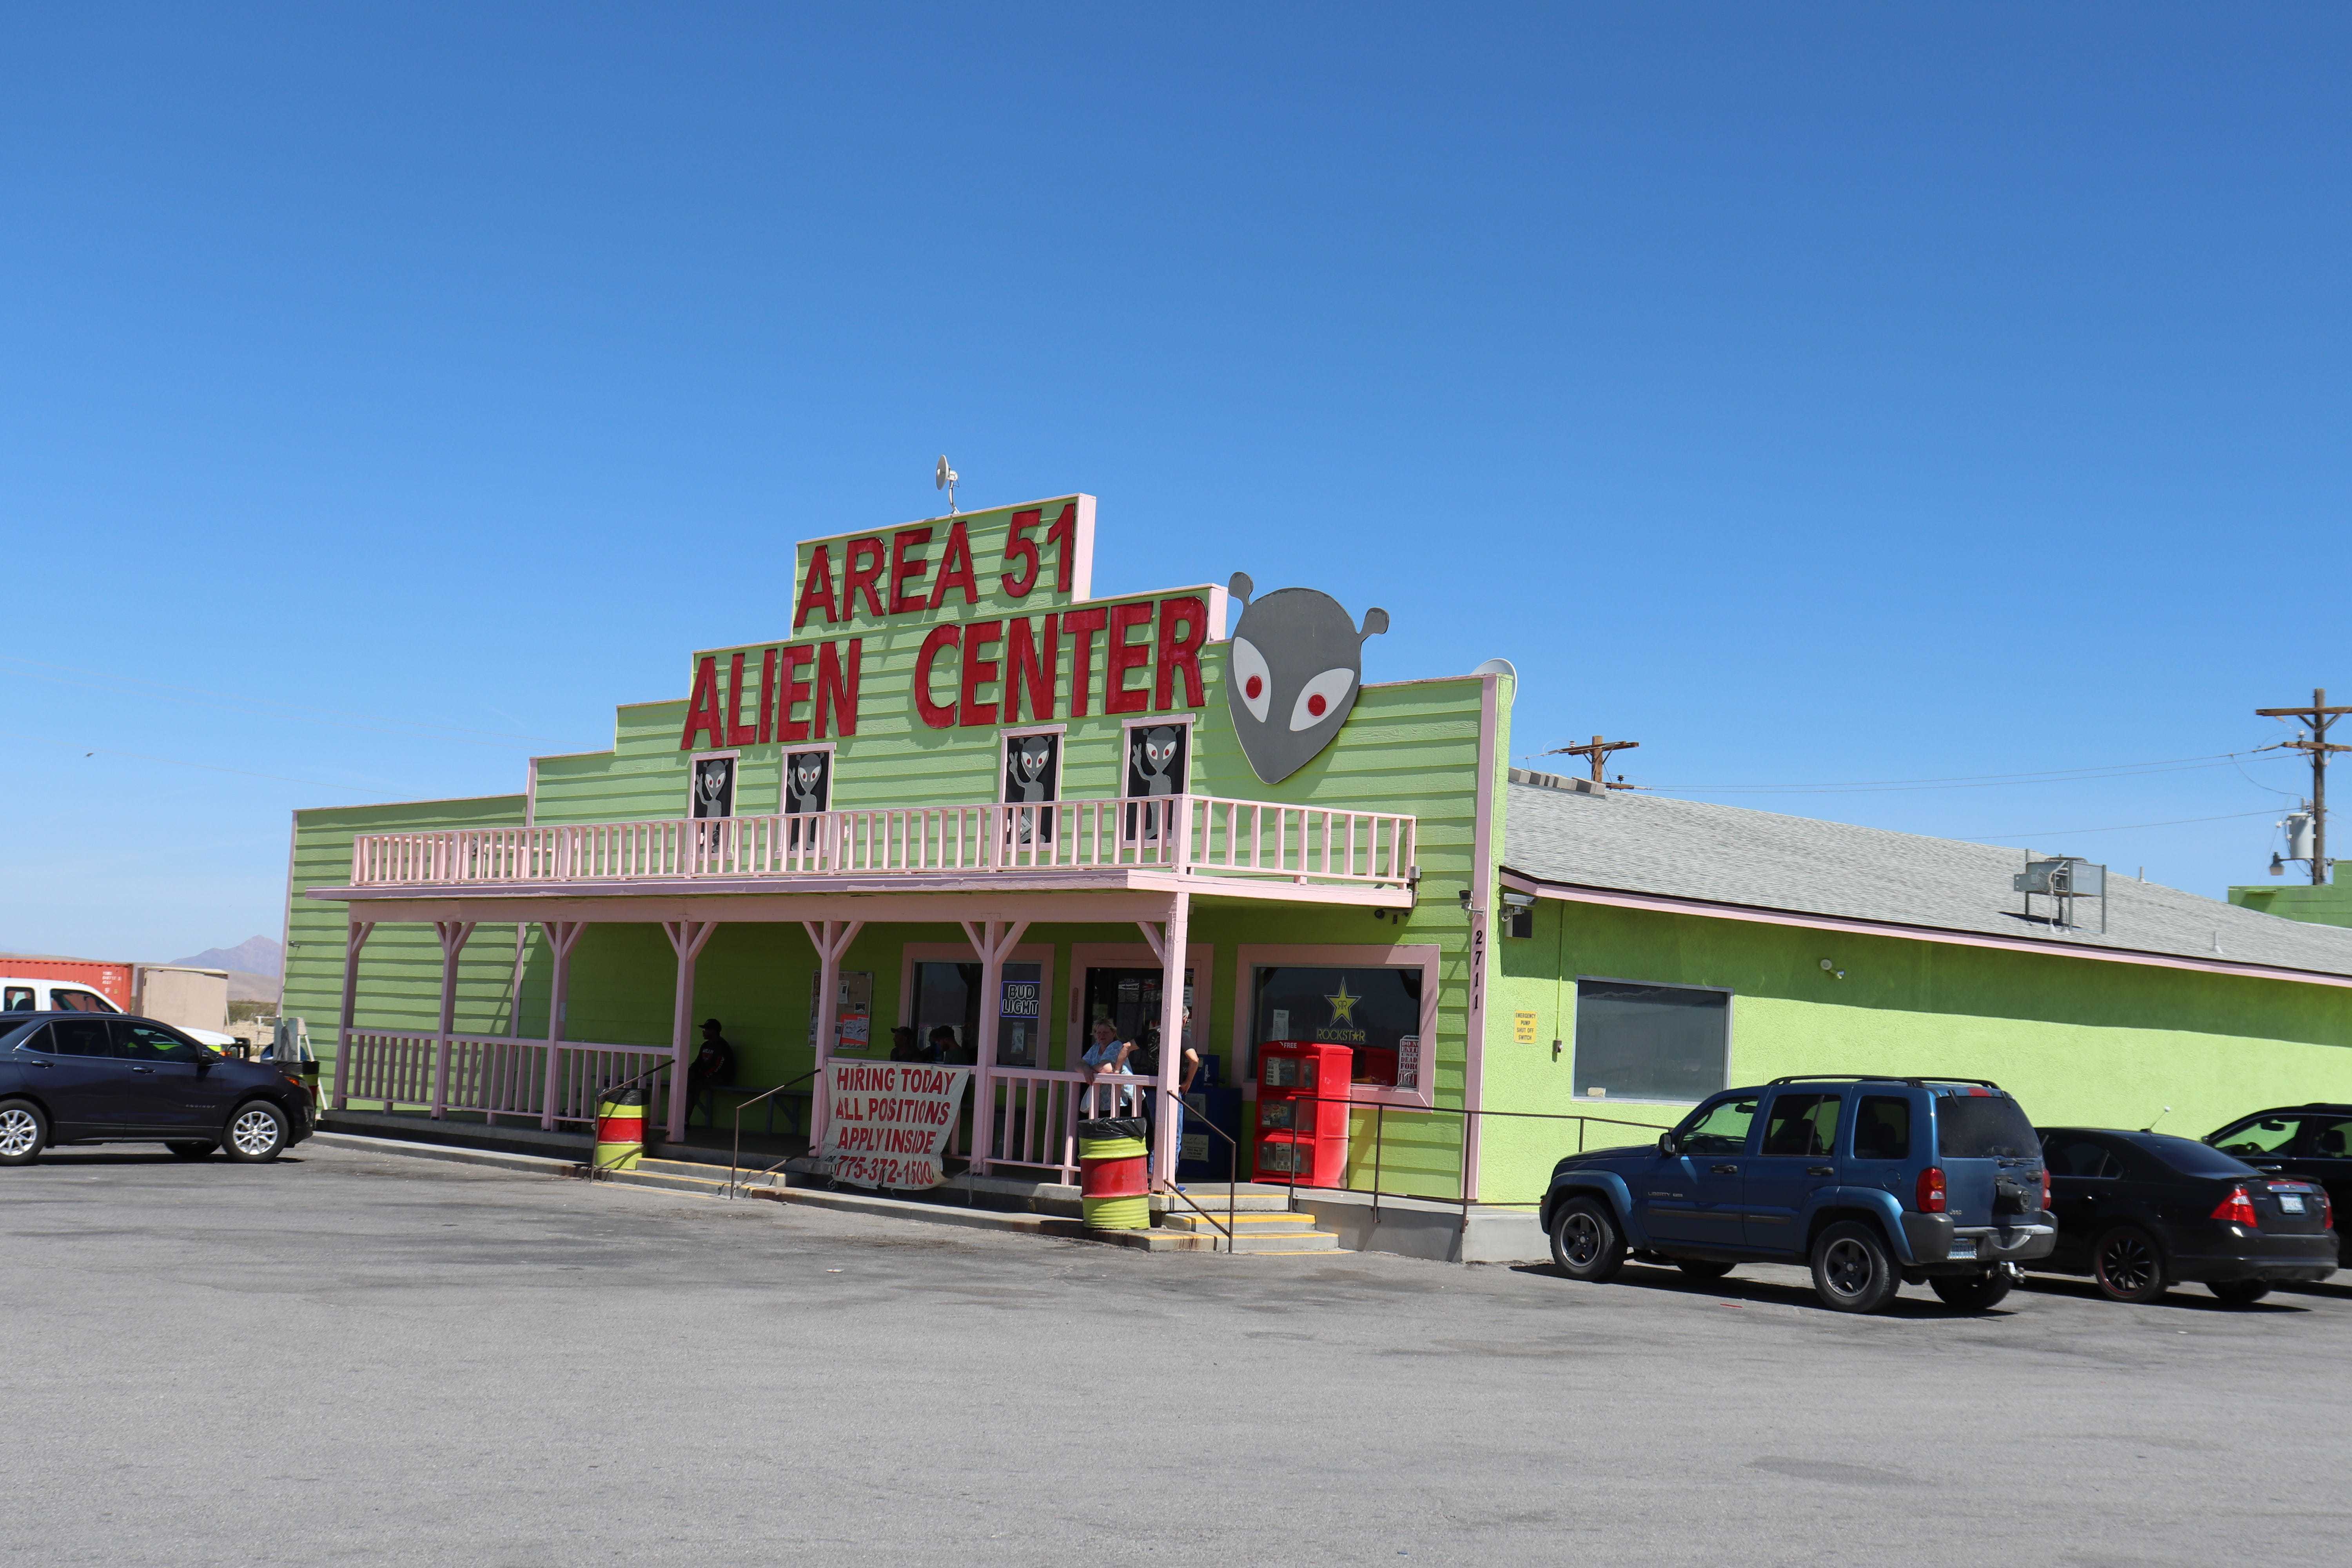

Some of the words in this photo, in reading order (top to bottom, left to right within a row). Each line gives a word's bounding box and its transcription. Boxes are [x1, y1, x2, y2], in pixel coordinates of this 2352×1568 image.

[793, 521, 979, 628] AREA
[1000, 502, 1075, 598] 51
[680, 638, 862, 750] ALIEN
[914, 596, 1209, 729] CENTER
[1474, 930, 1483, 1010] 2711
[1008, 985, 1035, 999] BUD
[1002, 999, 1039, 1014] LIGHT
[837, 1067, 895, 1092] HIRING
[901, 1068, 956, 1095] TODAY
[835, 1097, 863, 1121] ALL
[868, 1098, 951, 1125] POSITIONS
[837, 1127, 884, 1151] APPLY
[884, 1128, 937, 1154] INSIDE
[836, 1155, 934, 1185] 775-372-1500
